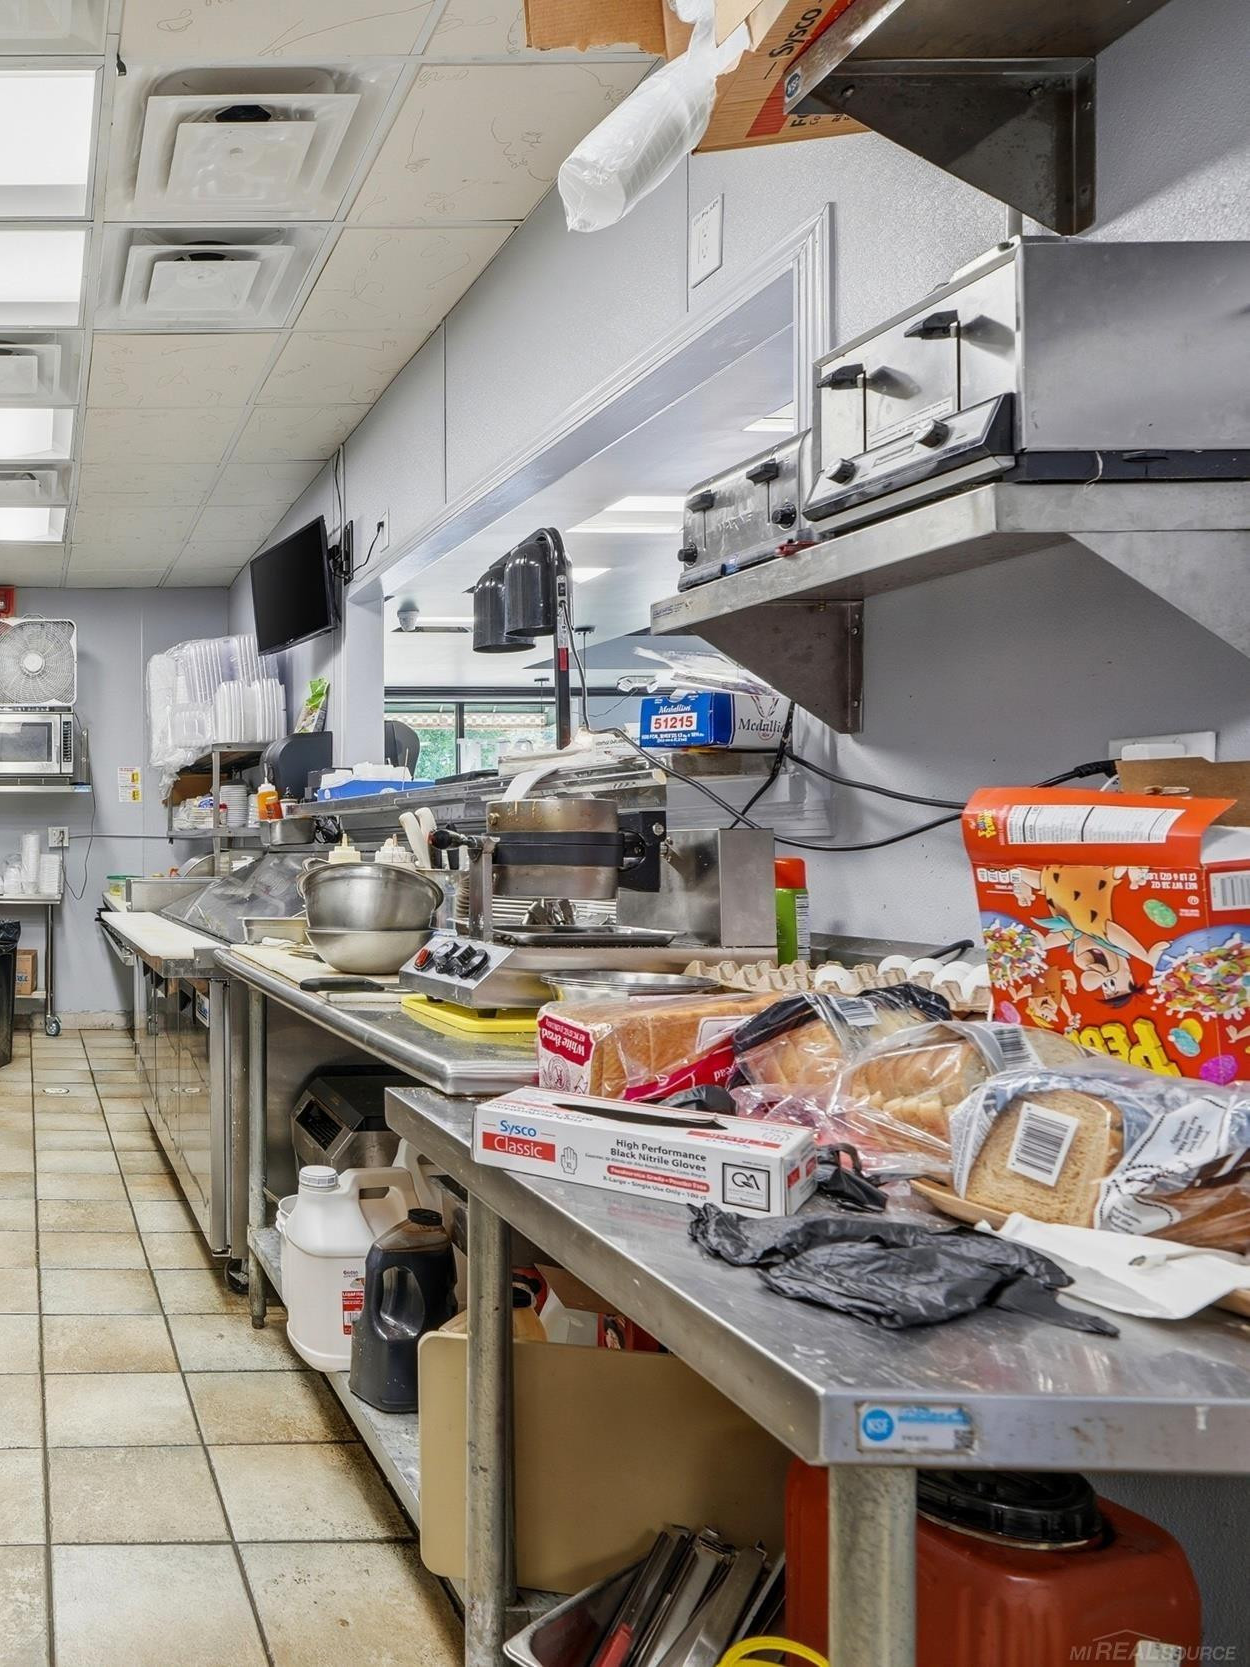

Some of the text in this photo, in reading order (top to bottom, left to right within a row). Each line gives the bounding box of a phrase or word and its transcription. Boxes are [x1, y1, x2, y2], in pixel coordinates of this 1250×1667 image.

[769, 8, 822, 58] Sysco
[654, 715, 694, 730] 51215
[541, 1028, 562, 1047] Bread
[562, 1038, 585, 1057] White
[500, 1120, 537, 1137] Sysco
[494, 1136, 543, 1158] Classic
[616, 1139, 707, 1162] High Performance
[610, 1148, 707, 1172] Black Nitrile Gloves
[603, 1175, 627, 1185] X-Large
[631, 1181, 651, 1190] Single
[652, 1184, 665, 1192] Use
[665, 1187, 680, 1196] Only
